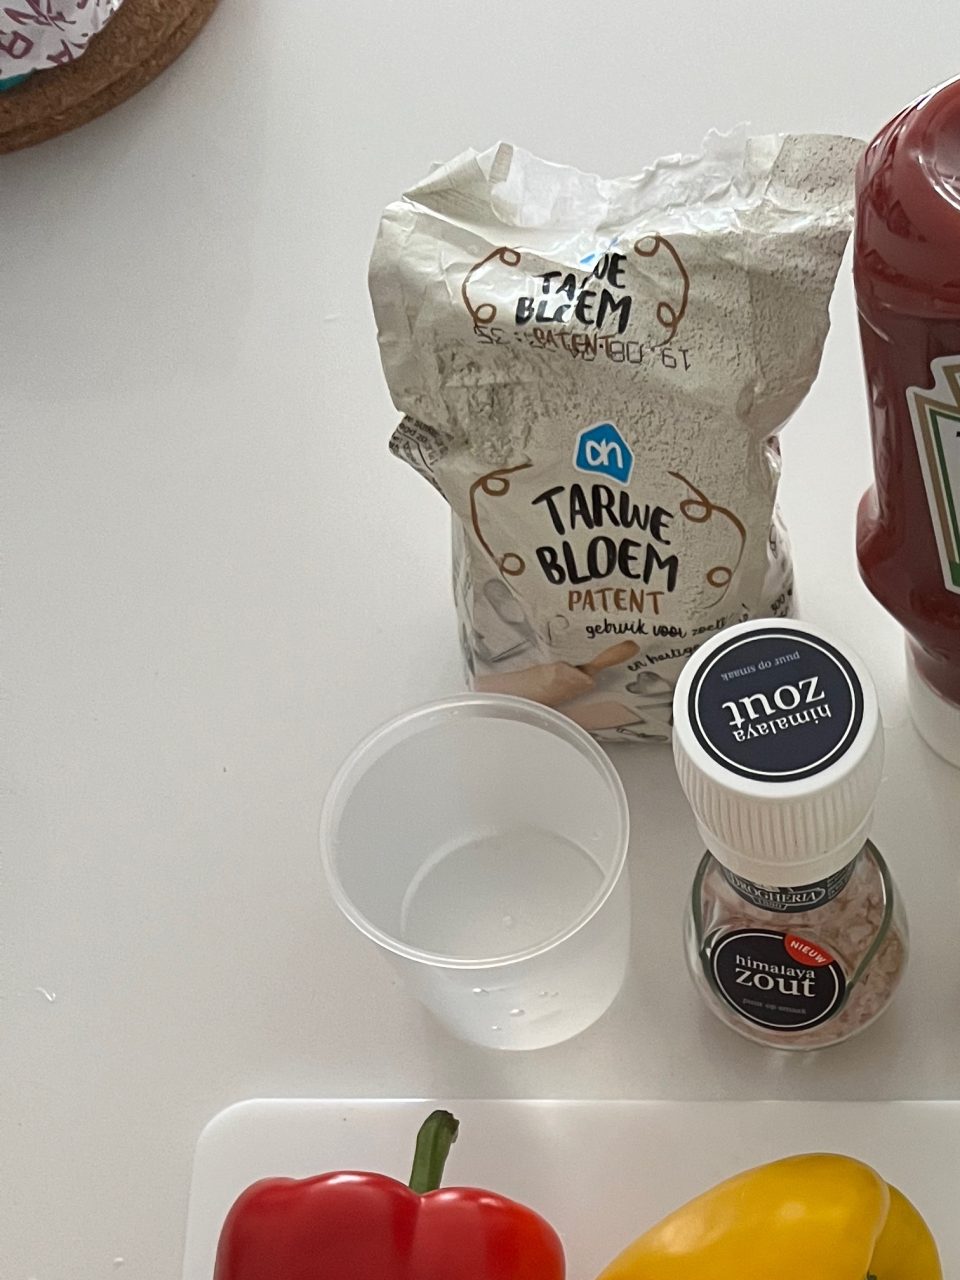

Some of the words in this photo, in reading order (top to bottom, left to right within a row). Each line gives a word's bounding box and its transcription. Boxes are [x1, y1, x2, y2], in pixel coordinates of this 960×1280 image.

[534, 252, 628, 300] TAE
[531, 483, 675, 546] TARWE
[535, 535, 679, 593] BLOEM
[567, 587, 665, 615] PATENT
[585, 618, 649, 639] gebruik
[652, 625, 687, 638] voor
[758, 660, 772, 671] op
[774, 650, 801, 665] puur
[720, 664, 756, 681] smaak
[721, 676, 825, 729] zout
[732, 704, 832, 742] himalaya
[790, 939, 827, 964] NIEUW
[735, 954, 816, 979] himalaya
[735, 967, 817, 998] zout
